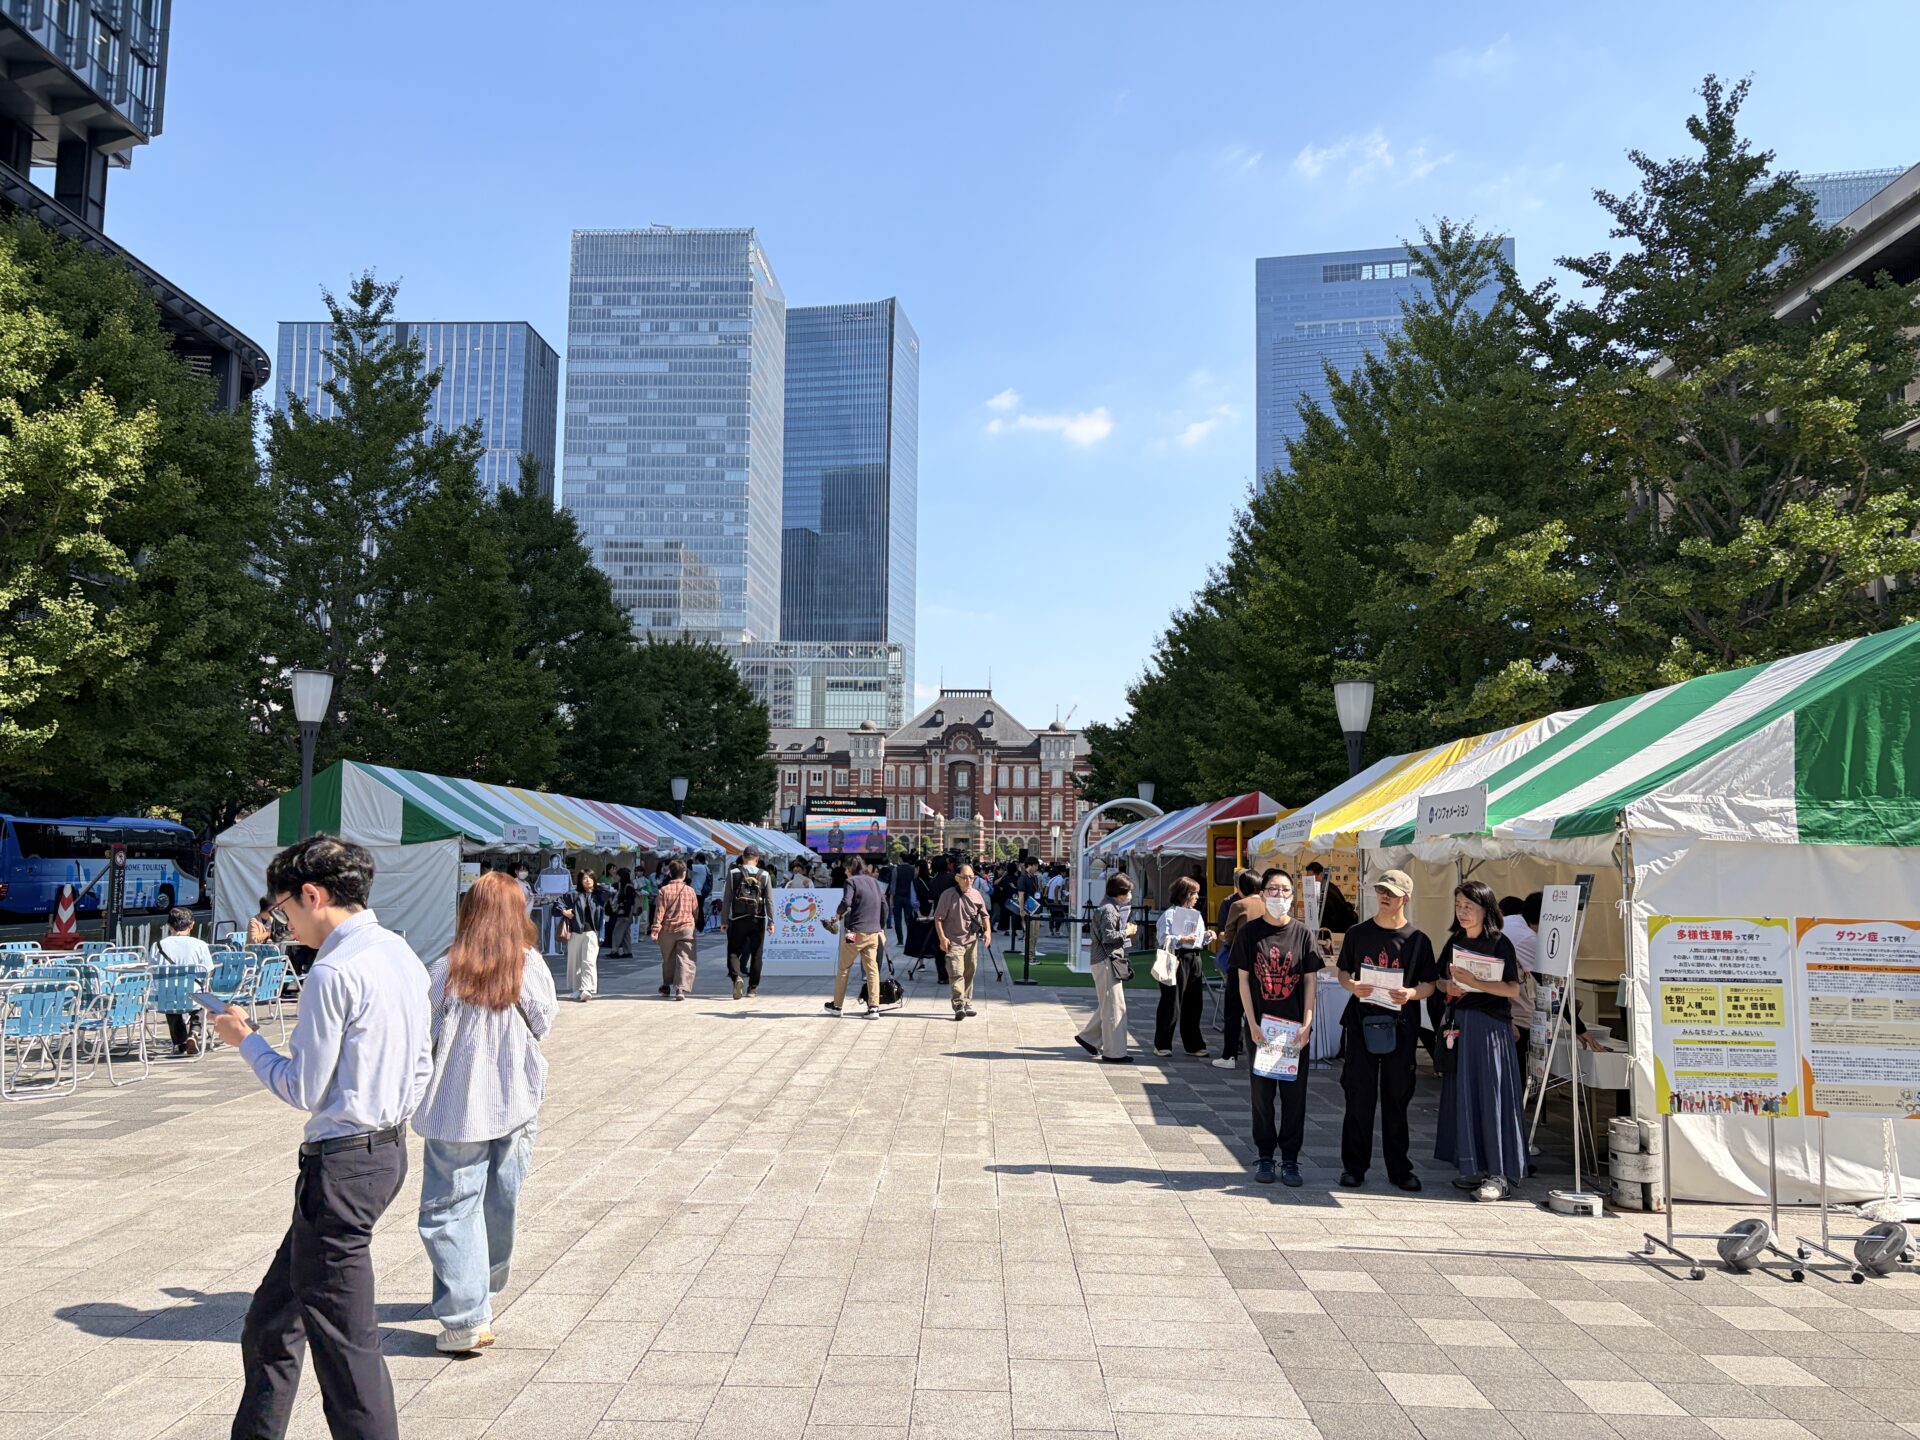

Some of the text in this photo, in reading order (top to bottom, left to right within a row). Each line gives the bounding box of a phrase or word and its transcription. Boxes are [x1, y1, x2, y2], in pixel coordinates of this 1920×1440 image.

[1434, 804, 1470, 820] インフォメーション
[142, 863, 167, 871] TOURIST
[1542, 913, 1572, 922] インフォメーション
[1664, 995, 1685, 1005] 性別
[1686, 1001, 1703, 1009] 人種
[1750, 1002, 1776, 1011] 価値観
